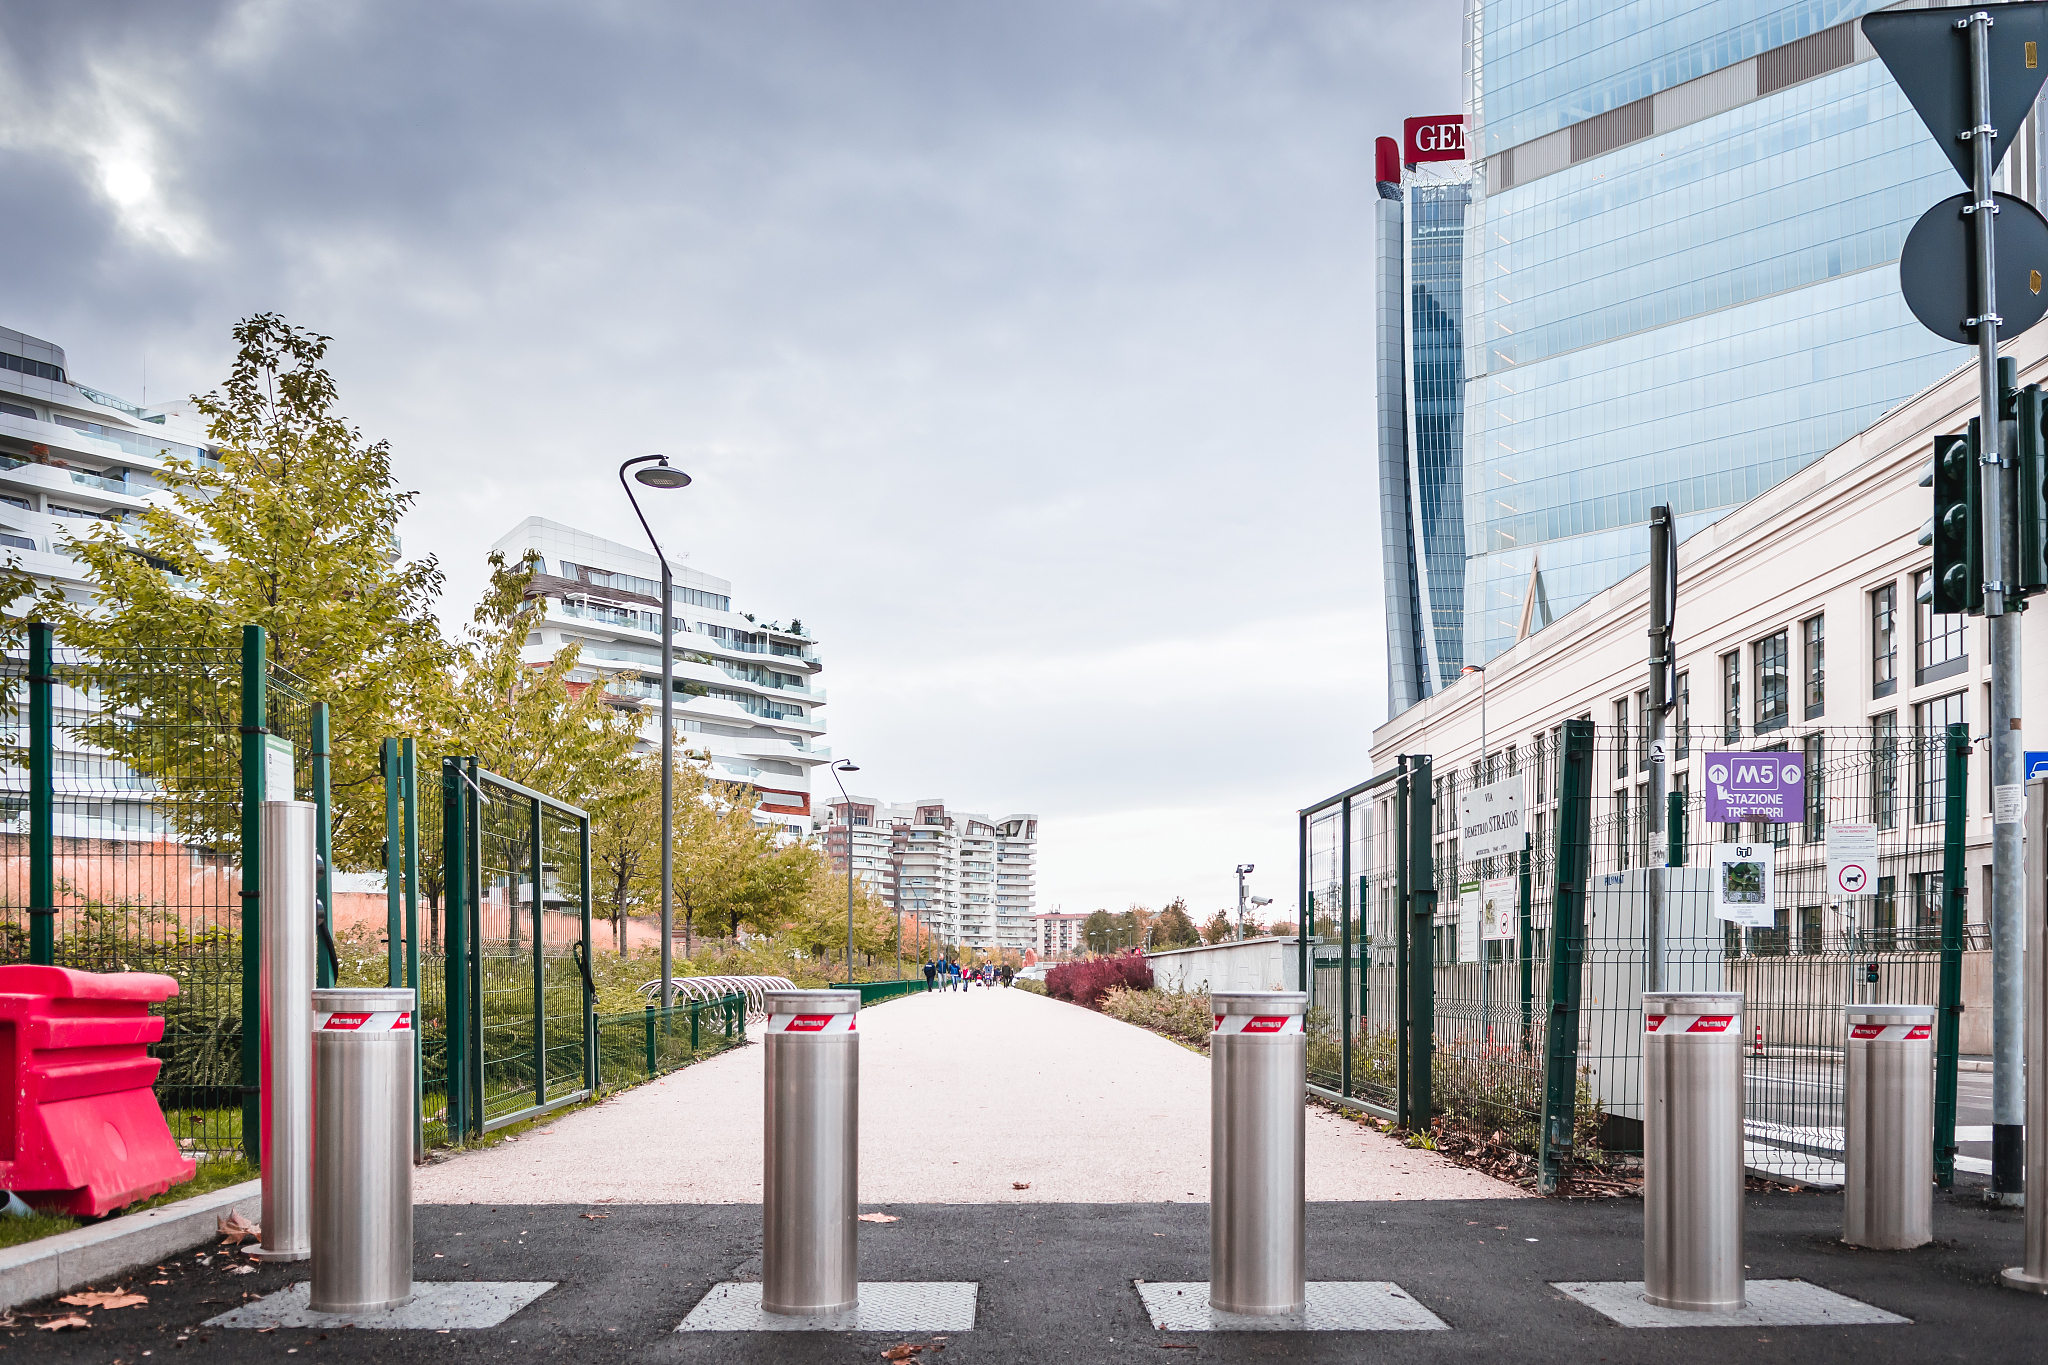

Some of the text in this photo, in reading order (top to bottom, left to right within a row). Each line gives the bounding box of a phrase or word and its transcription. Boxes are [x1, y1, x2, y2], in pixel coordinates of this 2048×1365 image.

[1736, 765, 1774, 784] M5
[1484, 792, 1494, 803] VIA
[1726, 793, 1784, 805] STAZIONE
[1726, 807, 1784, 818] TRE TORRI
[1464, 809, 1519, 839] DEMETRIO STRATOS
